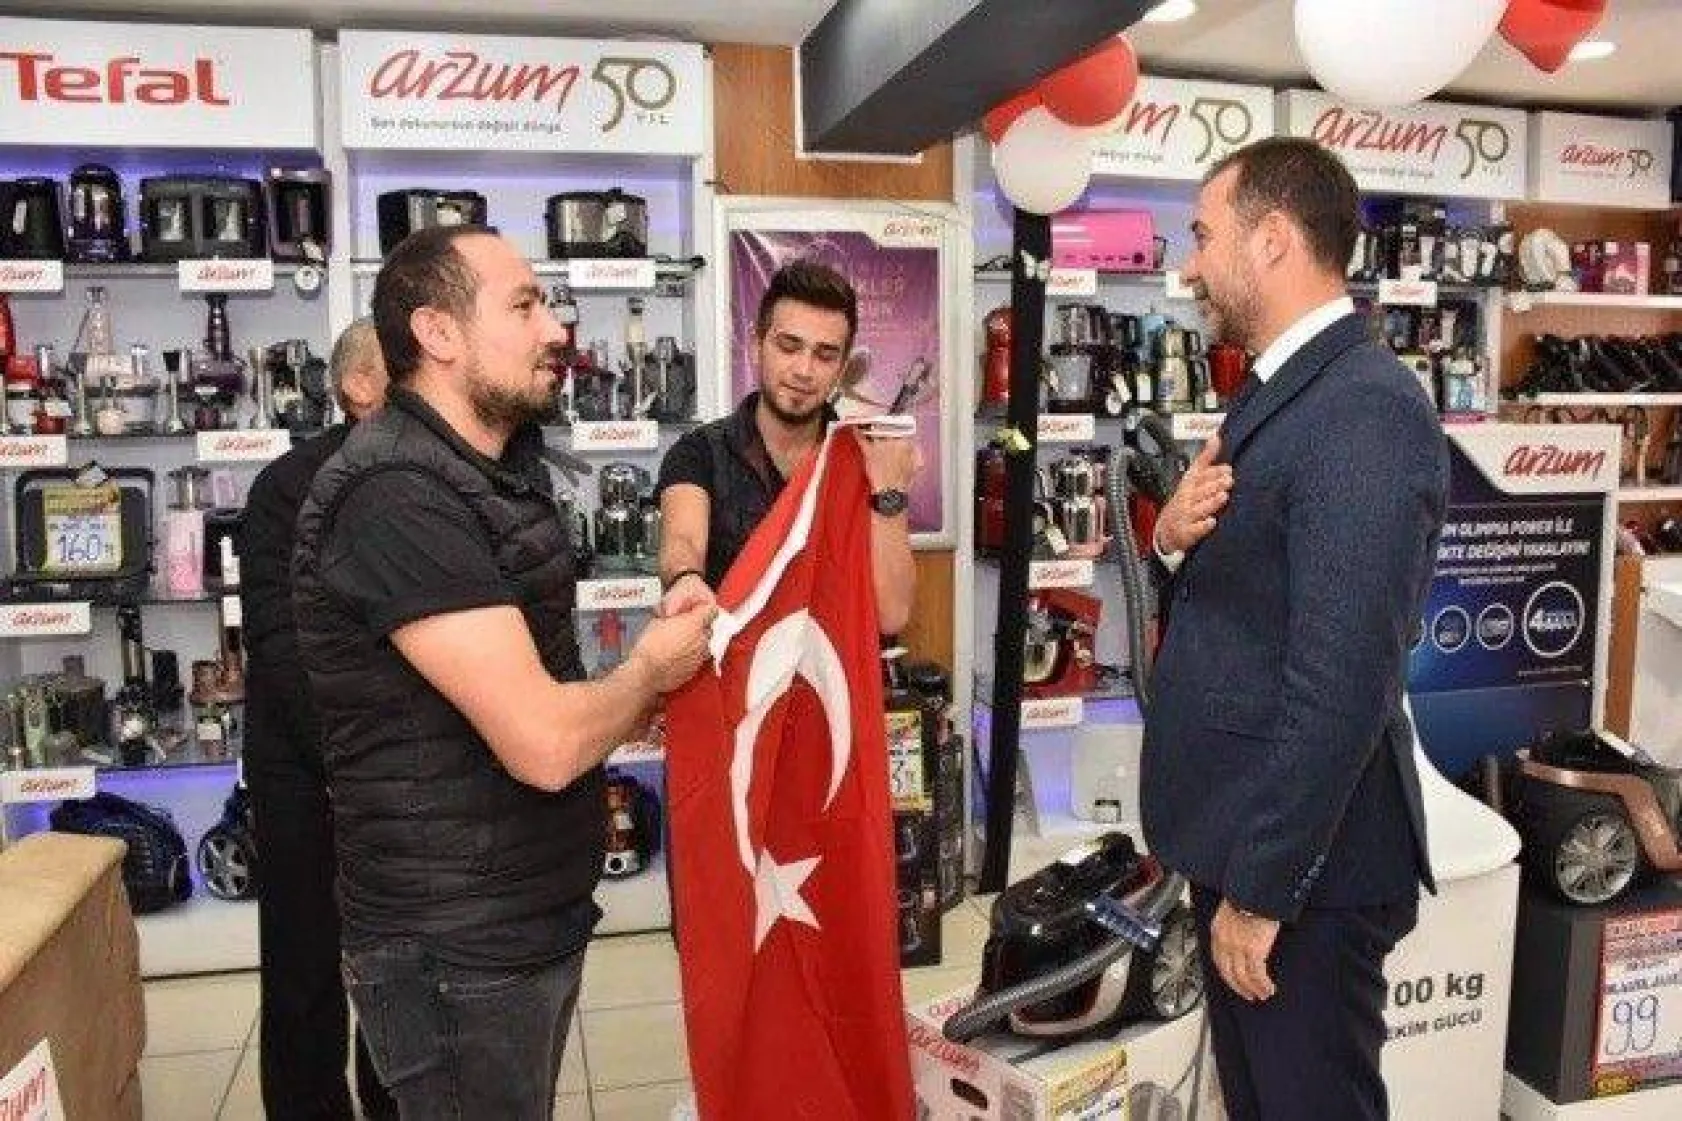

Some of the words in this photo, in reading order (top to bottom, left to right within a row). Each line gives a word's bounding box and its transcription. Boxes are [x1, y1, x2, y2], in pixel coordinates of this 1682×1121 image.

[0, 52, 229, 106] Tefal
[370, 49, 580, 113] arzum
[591, 57, 676, 132] 50
[1189, 98, 1254, 163] 50
[1311, 106, 1448, 163] arzum
[1455, 117, 1509, 179] 50
[1504, 444, 1606, 482] arzum
[1445, 972, 1485, 1001] kg
[1606, 994, 1660, 1056] 99
